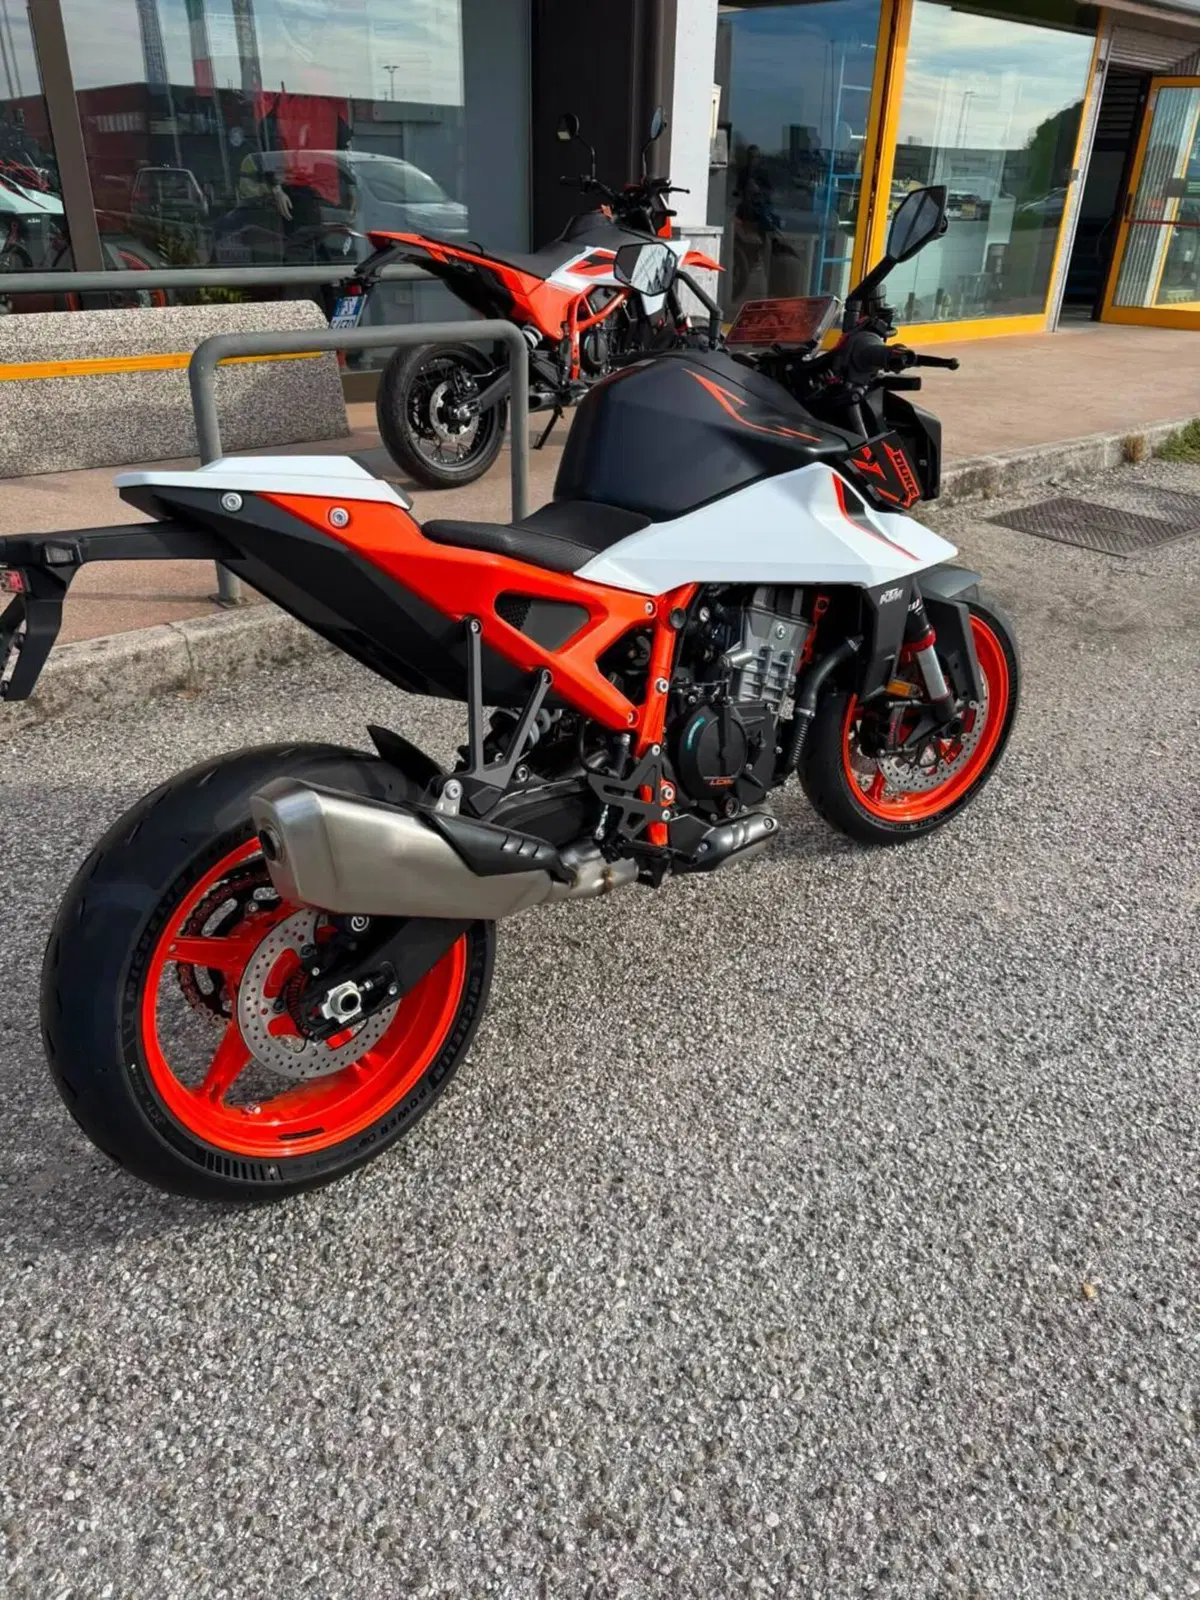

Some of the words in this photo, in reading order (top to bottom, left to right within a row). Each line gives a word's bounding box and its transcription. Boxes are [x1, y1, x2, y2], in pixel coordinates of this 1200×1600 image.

[890, 449, 920, 497] DUKE
[880, 588, 903, 604] KTM
[433, 976, 481, 1081] MICHELIN
[380, 1087, 427, 1135] POWER
